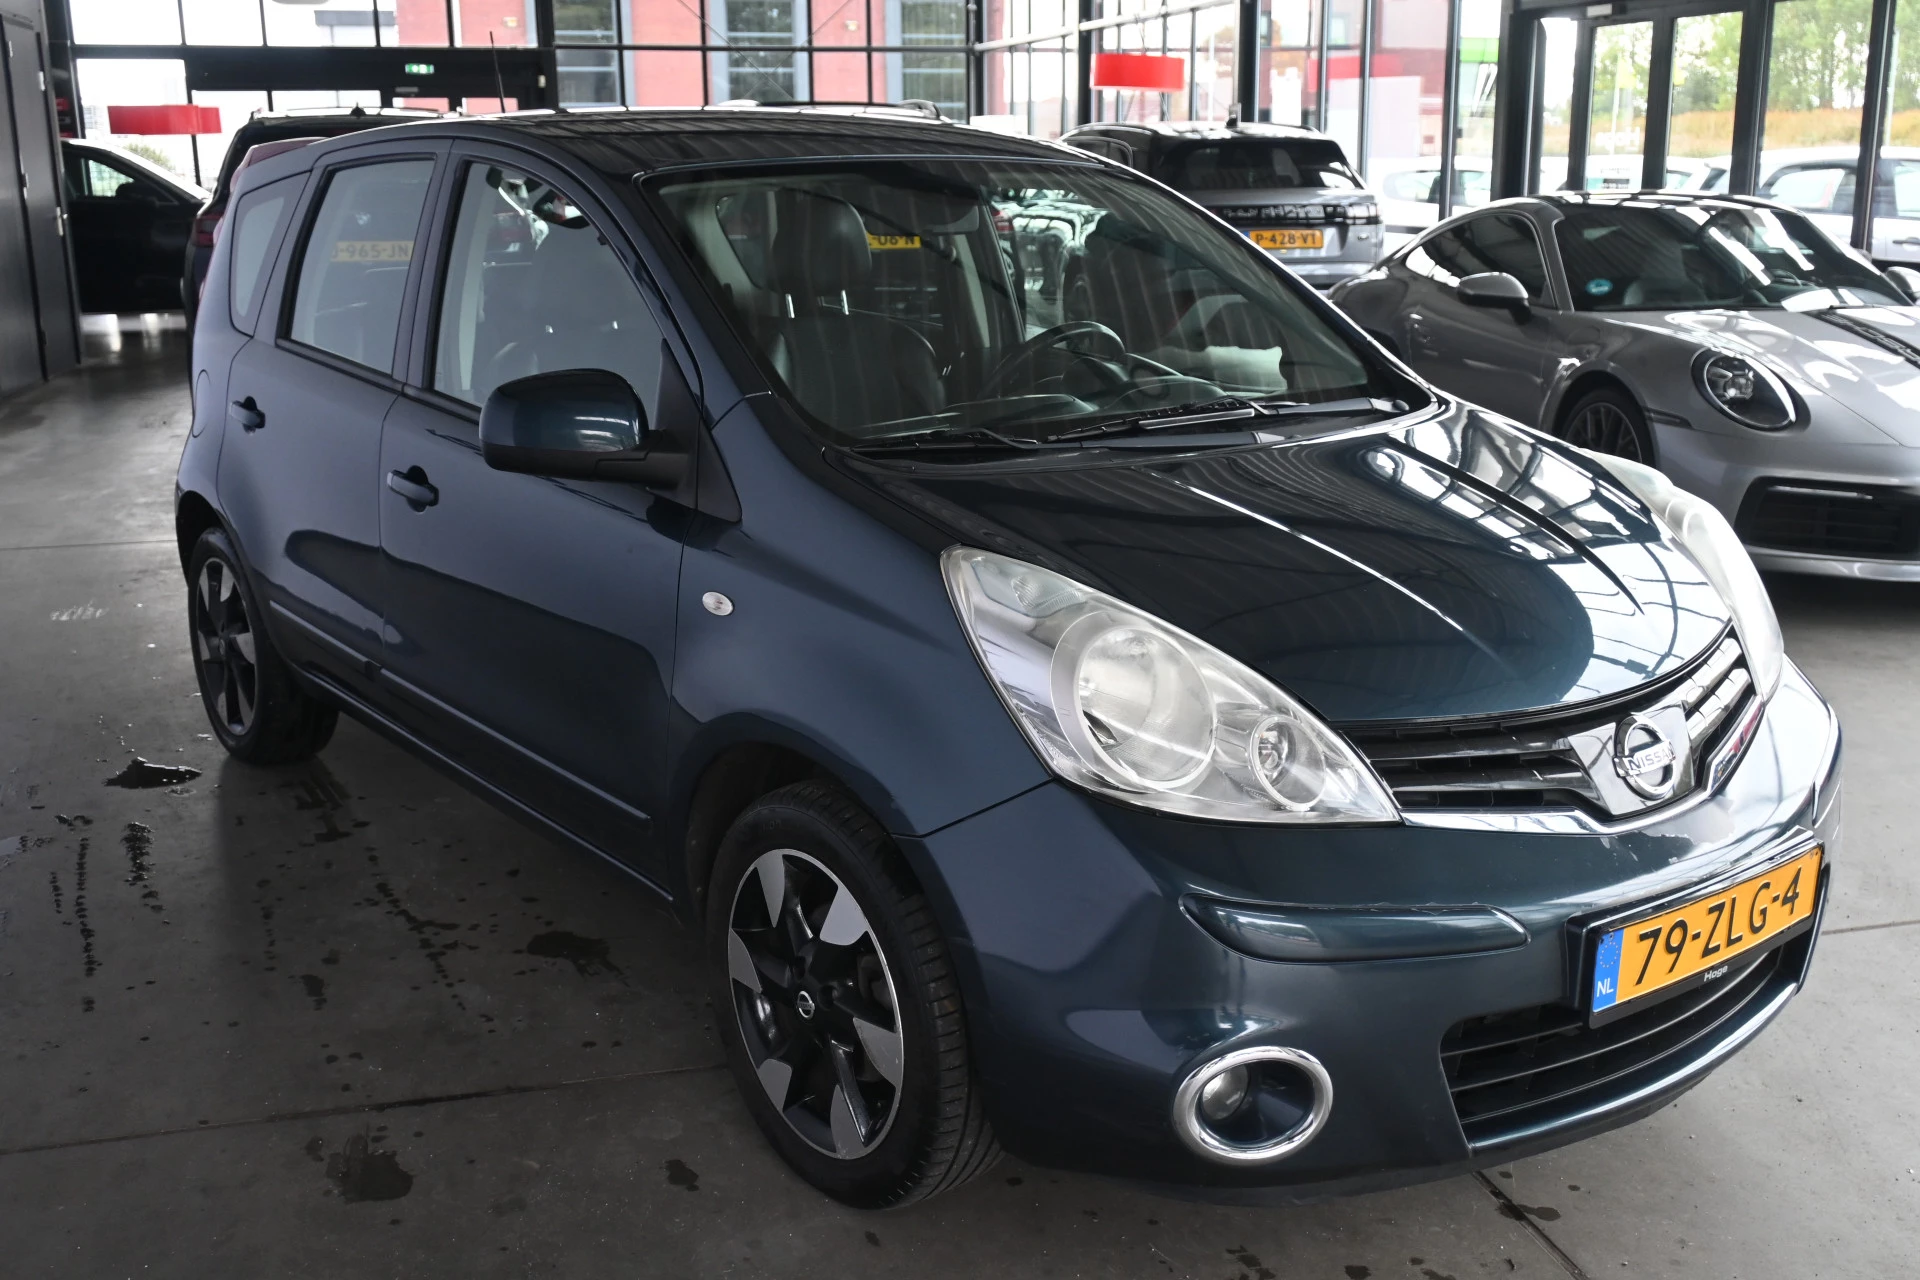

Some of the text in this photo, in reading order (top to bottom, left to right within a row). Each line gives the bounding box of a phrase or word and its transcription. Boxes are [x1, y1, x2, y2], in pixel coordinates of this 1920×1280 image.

[1634, 866, 1802, 986] 79-ZLG-4
[1703, 965, 1728, 982] Hoge
[1596, 977, 1614, 997] NL
